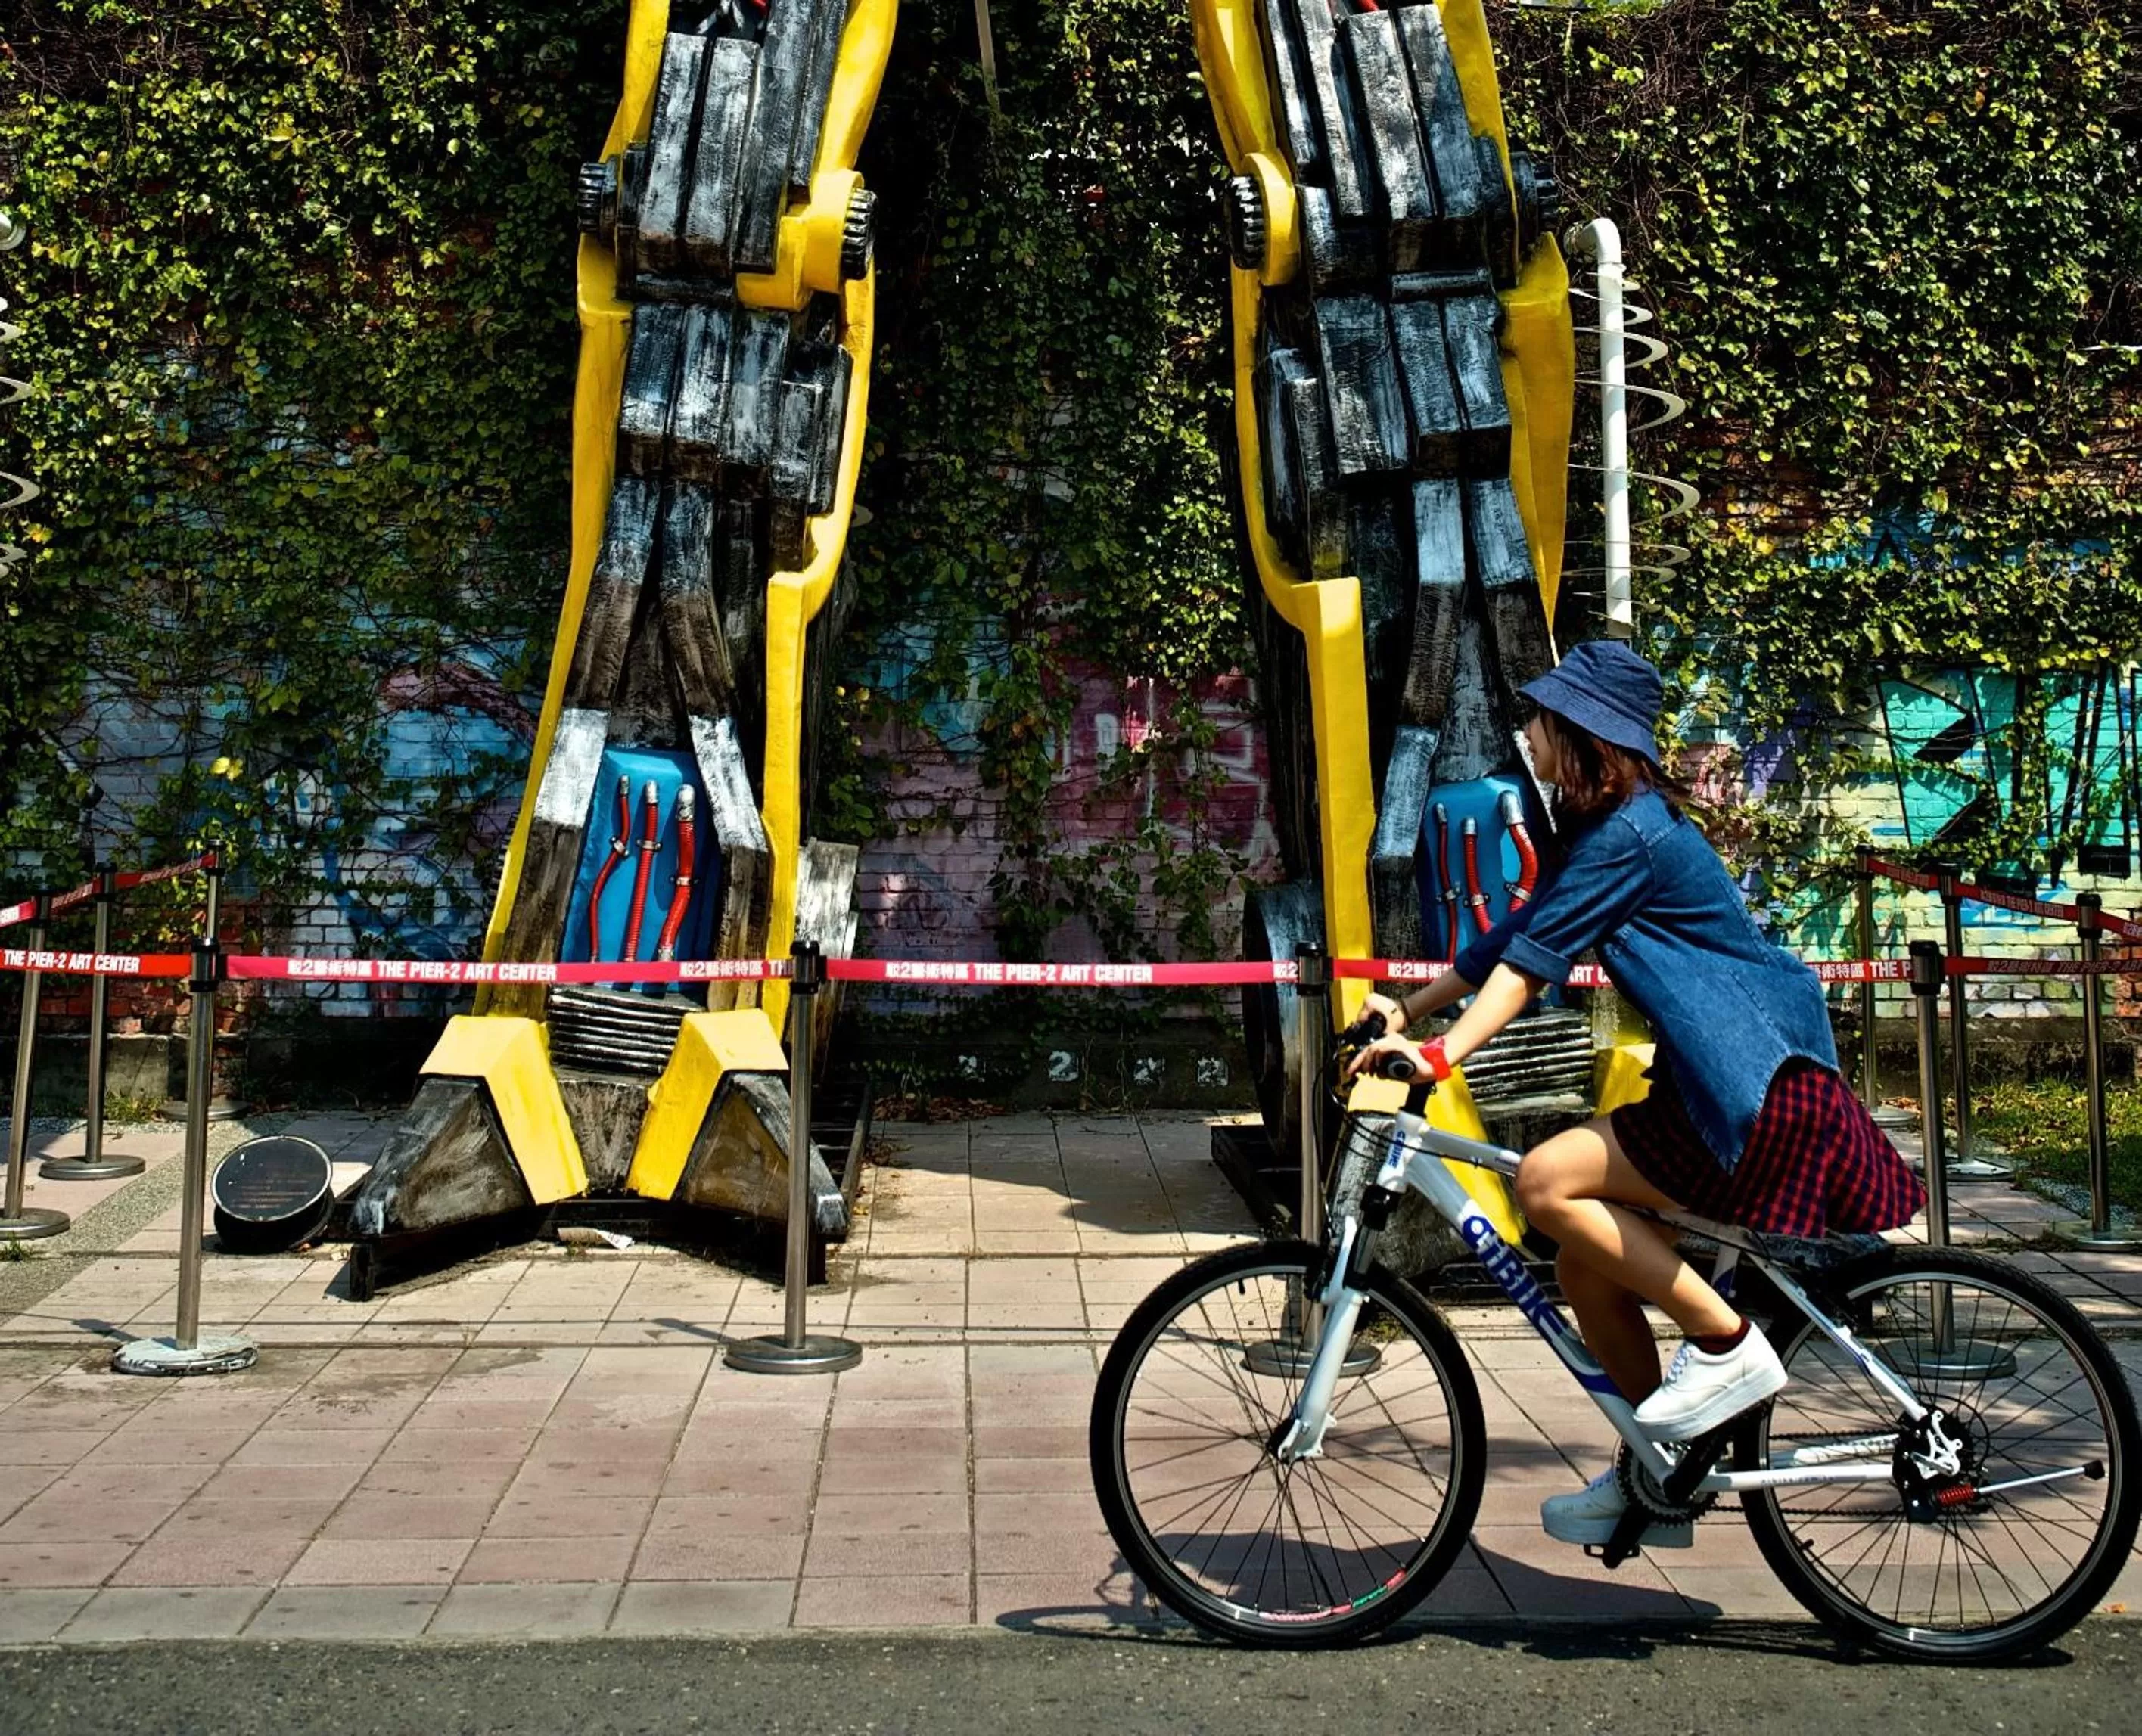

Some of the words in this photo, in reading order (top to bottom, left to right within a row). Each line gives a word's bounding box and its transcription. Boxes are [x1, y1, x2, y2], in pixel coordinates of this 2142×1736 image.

[4, 949, 26, 967] THE
[27, 951, 65, 969] PIER-2
[68, 953, 92, 970] ART
[94, 954, 140, 974] CENTER
[377, 961, 406, 977] THE
[409, 961, 461, 979] PIER-2
[464, 962, 494, 980] ART
[498, 963, 557, 981] CENTER
[1869, 961, 1898, 977] THE
[2057, 960, 2079, 973] THE
[2081, 961, 2121, 973] PIER-2
[974, 963, 1003, 980] THE
[1006, 964, 1056, 981] PIER-2
[1060, 964, 1092, 982] ART
[1094, 964, 1152, 983] CENTER
[1049, 1051, 1080, 1082] 2
